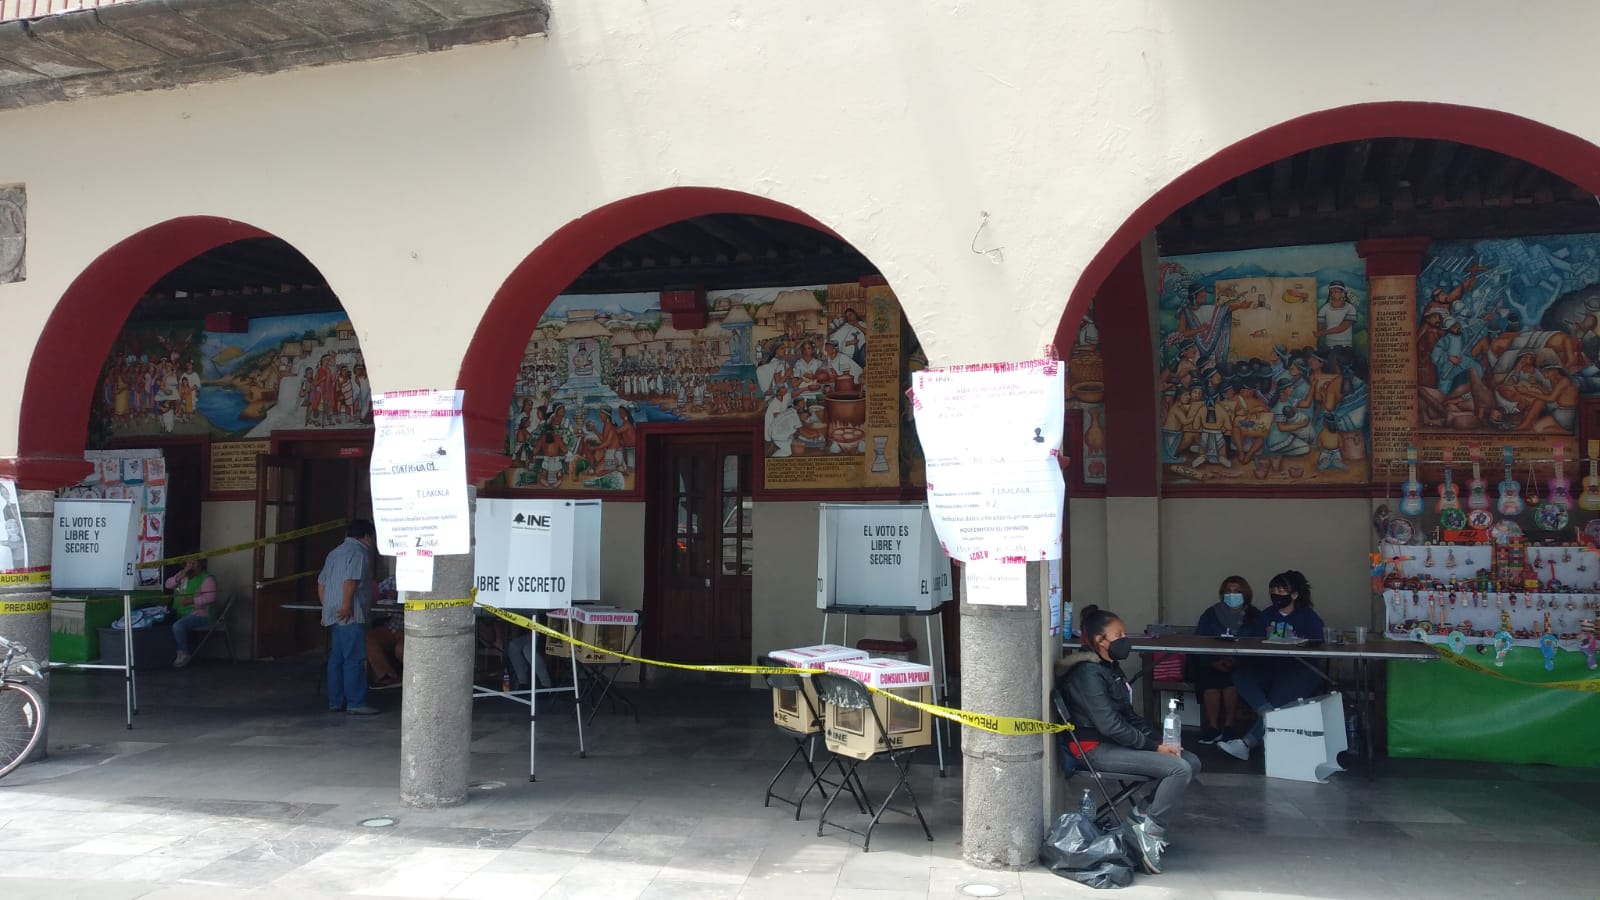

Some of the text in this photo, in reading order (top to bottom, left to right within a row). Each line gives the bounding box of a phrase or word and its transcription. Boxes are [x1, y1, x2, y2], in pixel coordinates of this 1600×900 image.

[59, 517, 107, 528] EL VOTO ES
[527, 515, 551, 527] INE
[64, 530, 100, 541] LIBRE Y
[863, 525, 909, 537] EL VOTO ES
[65, 543, 99, 553] SECRETO
[871, 540, 902, 551] LIBRE Y
[870, 554, 902, 565] SECRETO
[126, 562, 133, 576] EL
[0, 574, 29, 583] AUCION
[476, 576, 566, 593] IBRE Y SECRETO
[921, 580, 929, 595] EL
[4, 601, 49, 613] PRECAUCION
[613, 614, 634, 623] POPULAR
[849, 668, 871, 683] POPULAR
[880, 671, 930, 685] CONSULTA POPULAR
[832, 732, 848, 742] INE
[889, 736, 904, 745] NE
